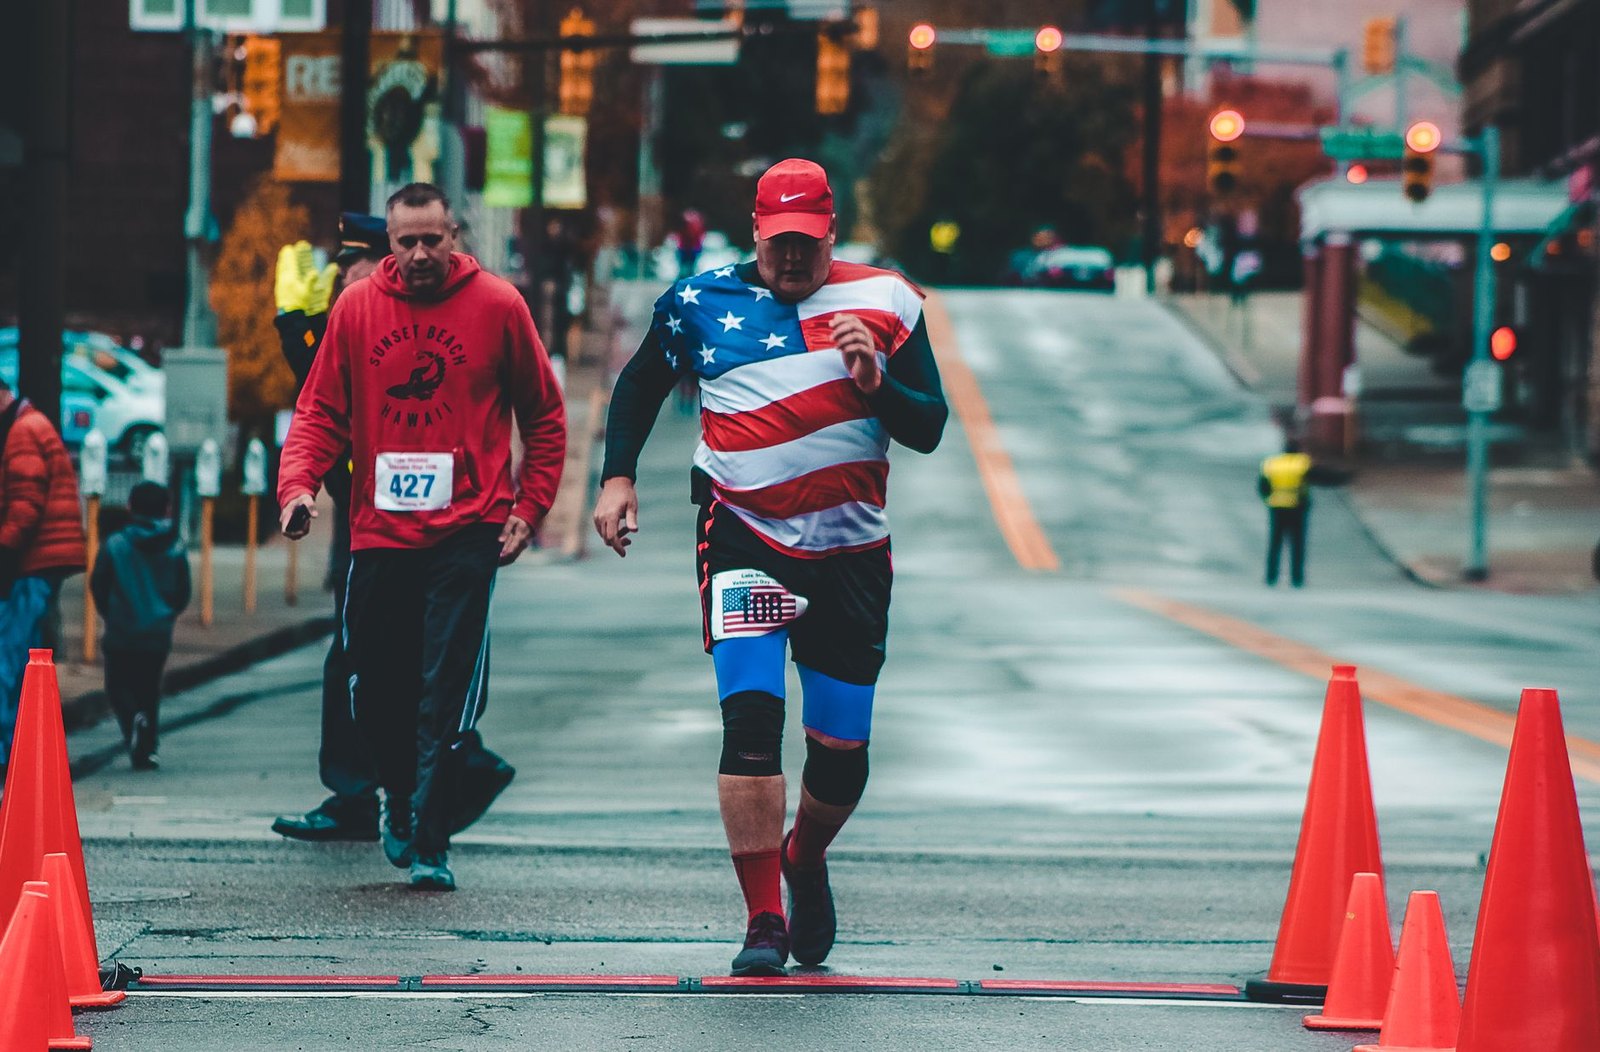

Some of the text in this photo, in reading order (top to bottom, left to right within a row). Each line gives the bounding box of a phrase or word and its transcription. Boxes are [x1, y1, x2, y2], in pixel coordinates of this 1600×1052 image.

[369, 324, 467, 367] SUNSET BEACH
[380, 401, 453, 427] HAWAII
[389, 474, 435, 498] 427
[742, 593, 782, 623] 108
